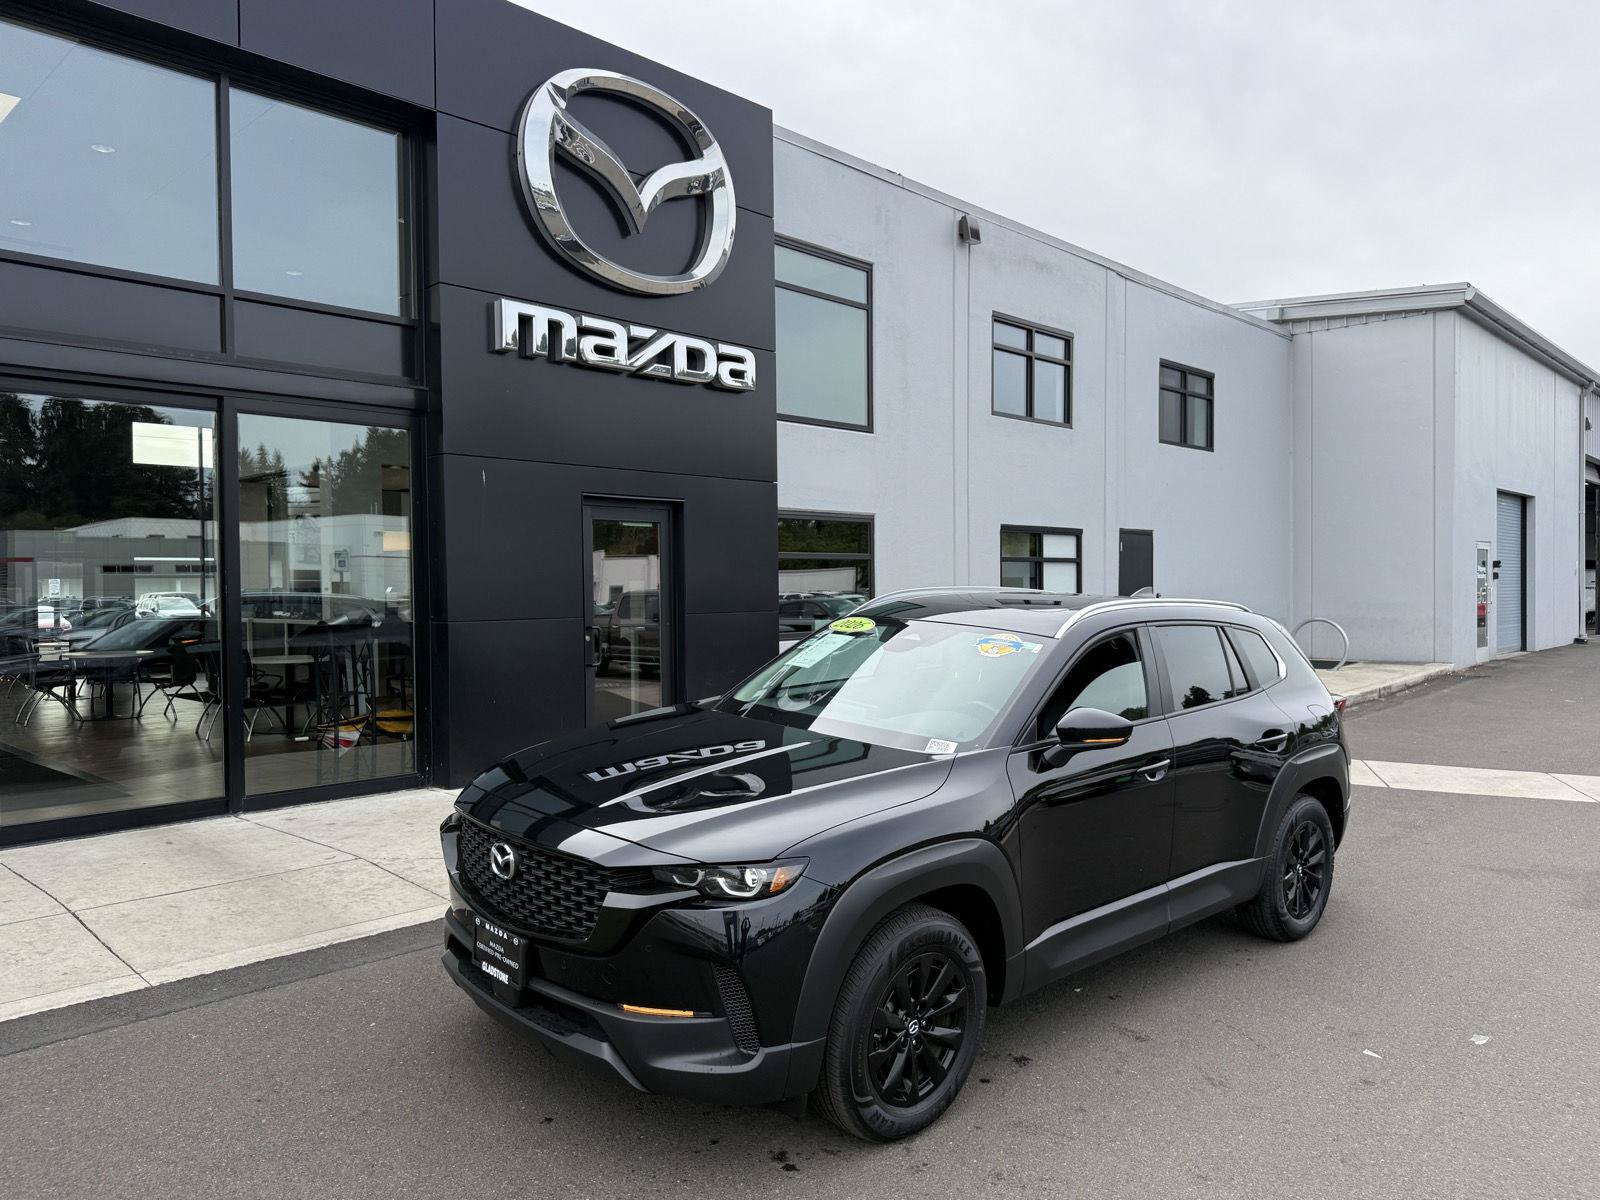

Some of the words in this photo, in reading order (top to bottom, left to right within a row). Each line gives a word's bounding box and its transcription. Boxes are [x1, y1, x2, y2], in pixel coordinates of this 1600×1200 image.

[490, 298, 756, 392] mazda
[485, 923, 508, 939] MAZDA
[490, 941, 504, 953] MAZDA
[482, 961, 508, 984] GLADSTONE
